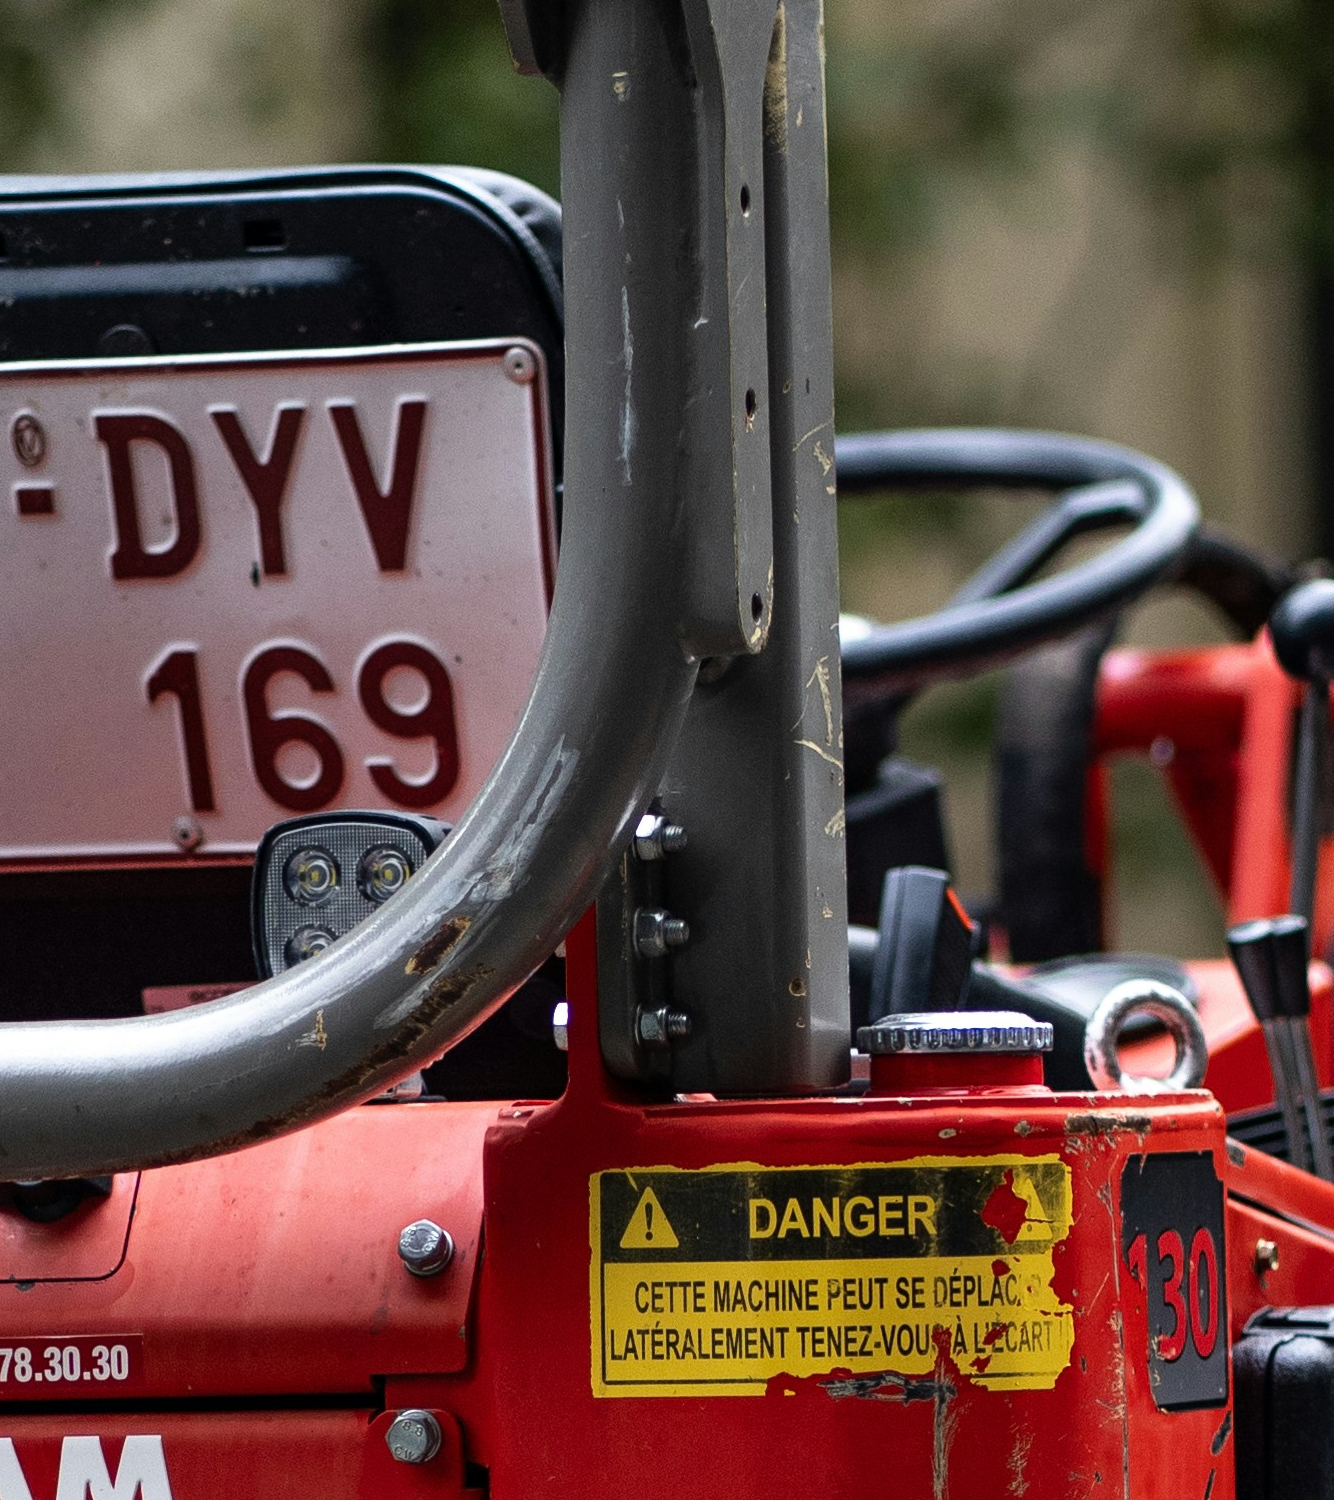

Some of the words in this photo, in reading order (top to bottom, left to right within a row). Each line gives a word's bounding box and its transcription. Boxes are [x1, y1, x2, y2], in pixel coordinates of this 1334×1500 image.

[144, 640, 462, 813] 169
[748, 1194, 938, 1239] DANGER
[634, 1280, 706, 1314] CETTE
[713, 1278, 820, 1313] MACHINE
[826, 1276, 889, 1312] PEUT
[895, 1274, 926, 1310] SE
[609, 1320, 790, 1361] LATÉRALEMENT
